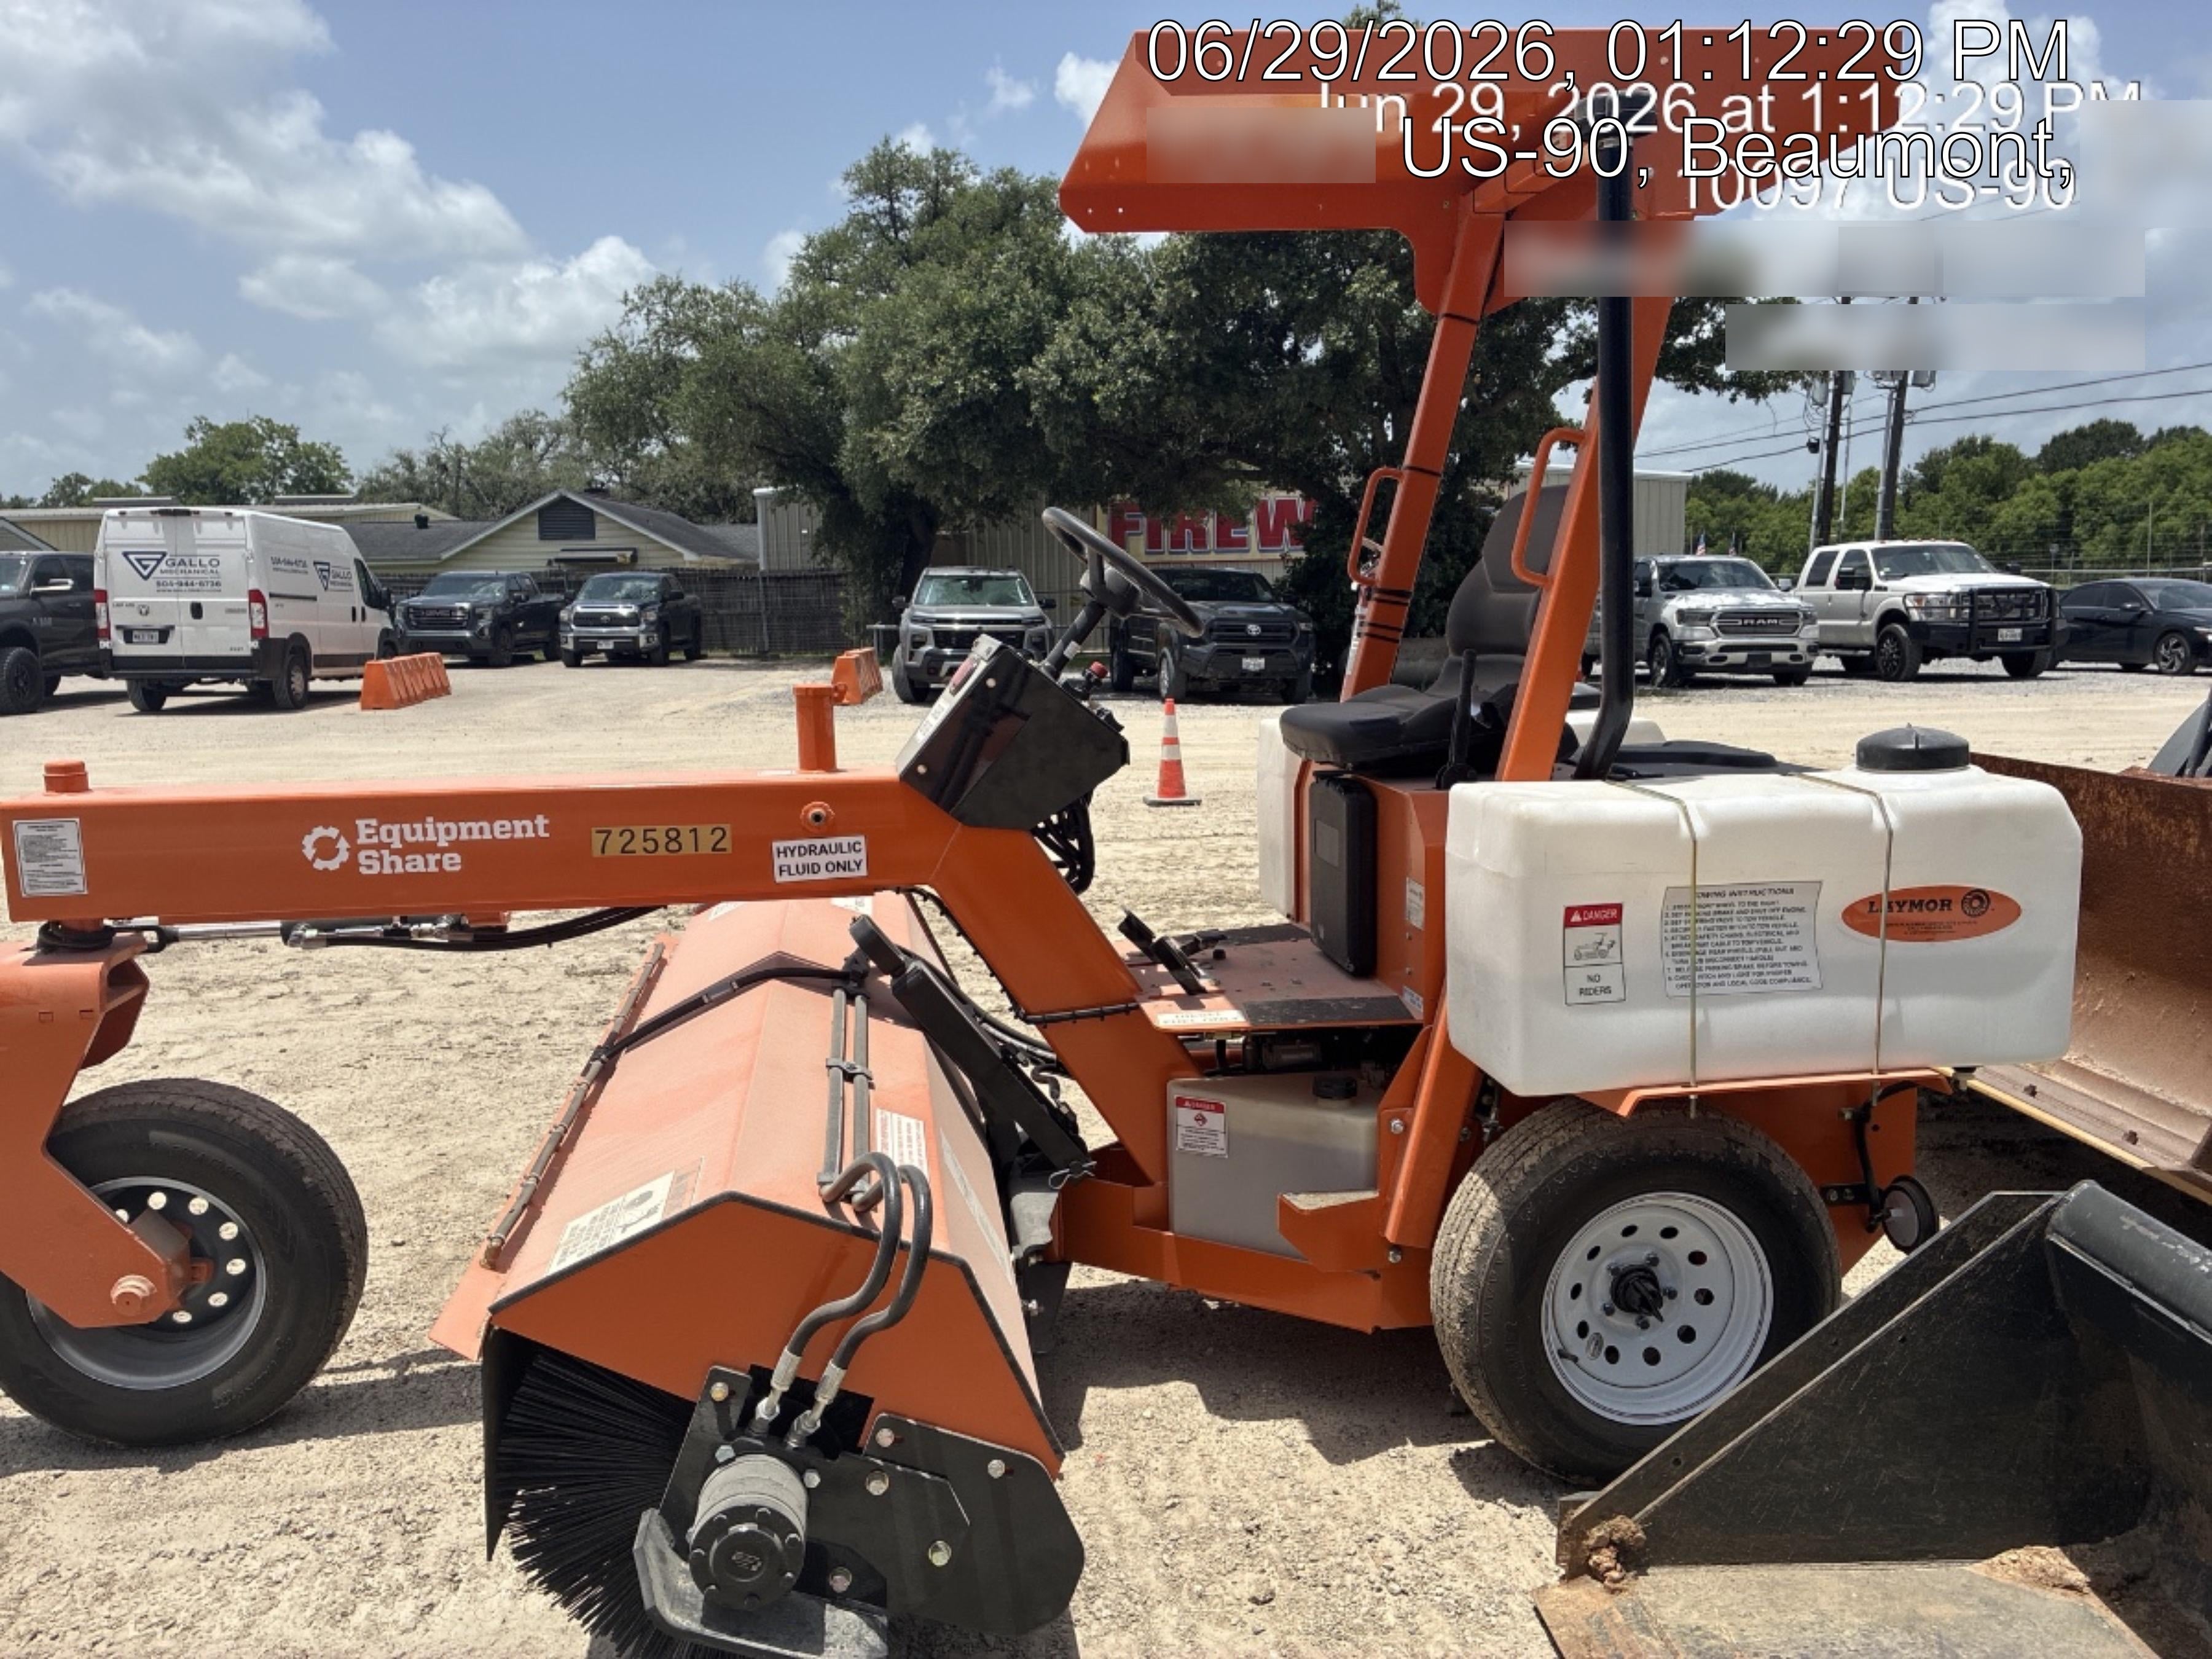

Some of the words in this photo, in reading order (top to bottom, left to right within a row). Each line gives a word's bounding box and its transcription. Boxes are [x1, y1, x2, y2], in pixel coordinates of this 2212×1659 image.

[165, 558, 220, 568] GALLO
[355, 814, 550, 849] Equipment
[595, 827, 728, 855] 725812
[776, 841, 863, 858] HYDRAULIC
[357, 849, 461, 874] Share
[778, 861, 821, 877] FLUID
[825, 859, 863, 873] ONLY
[1582, 909, 1617, 920] DANGER
[1586, 973, 1601, 983] NO
[1579, 986, 1612, 996] RIDERS
